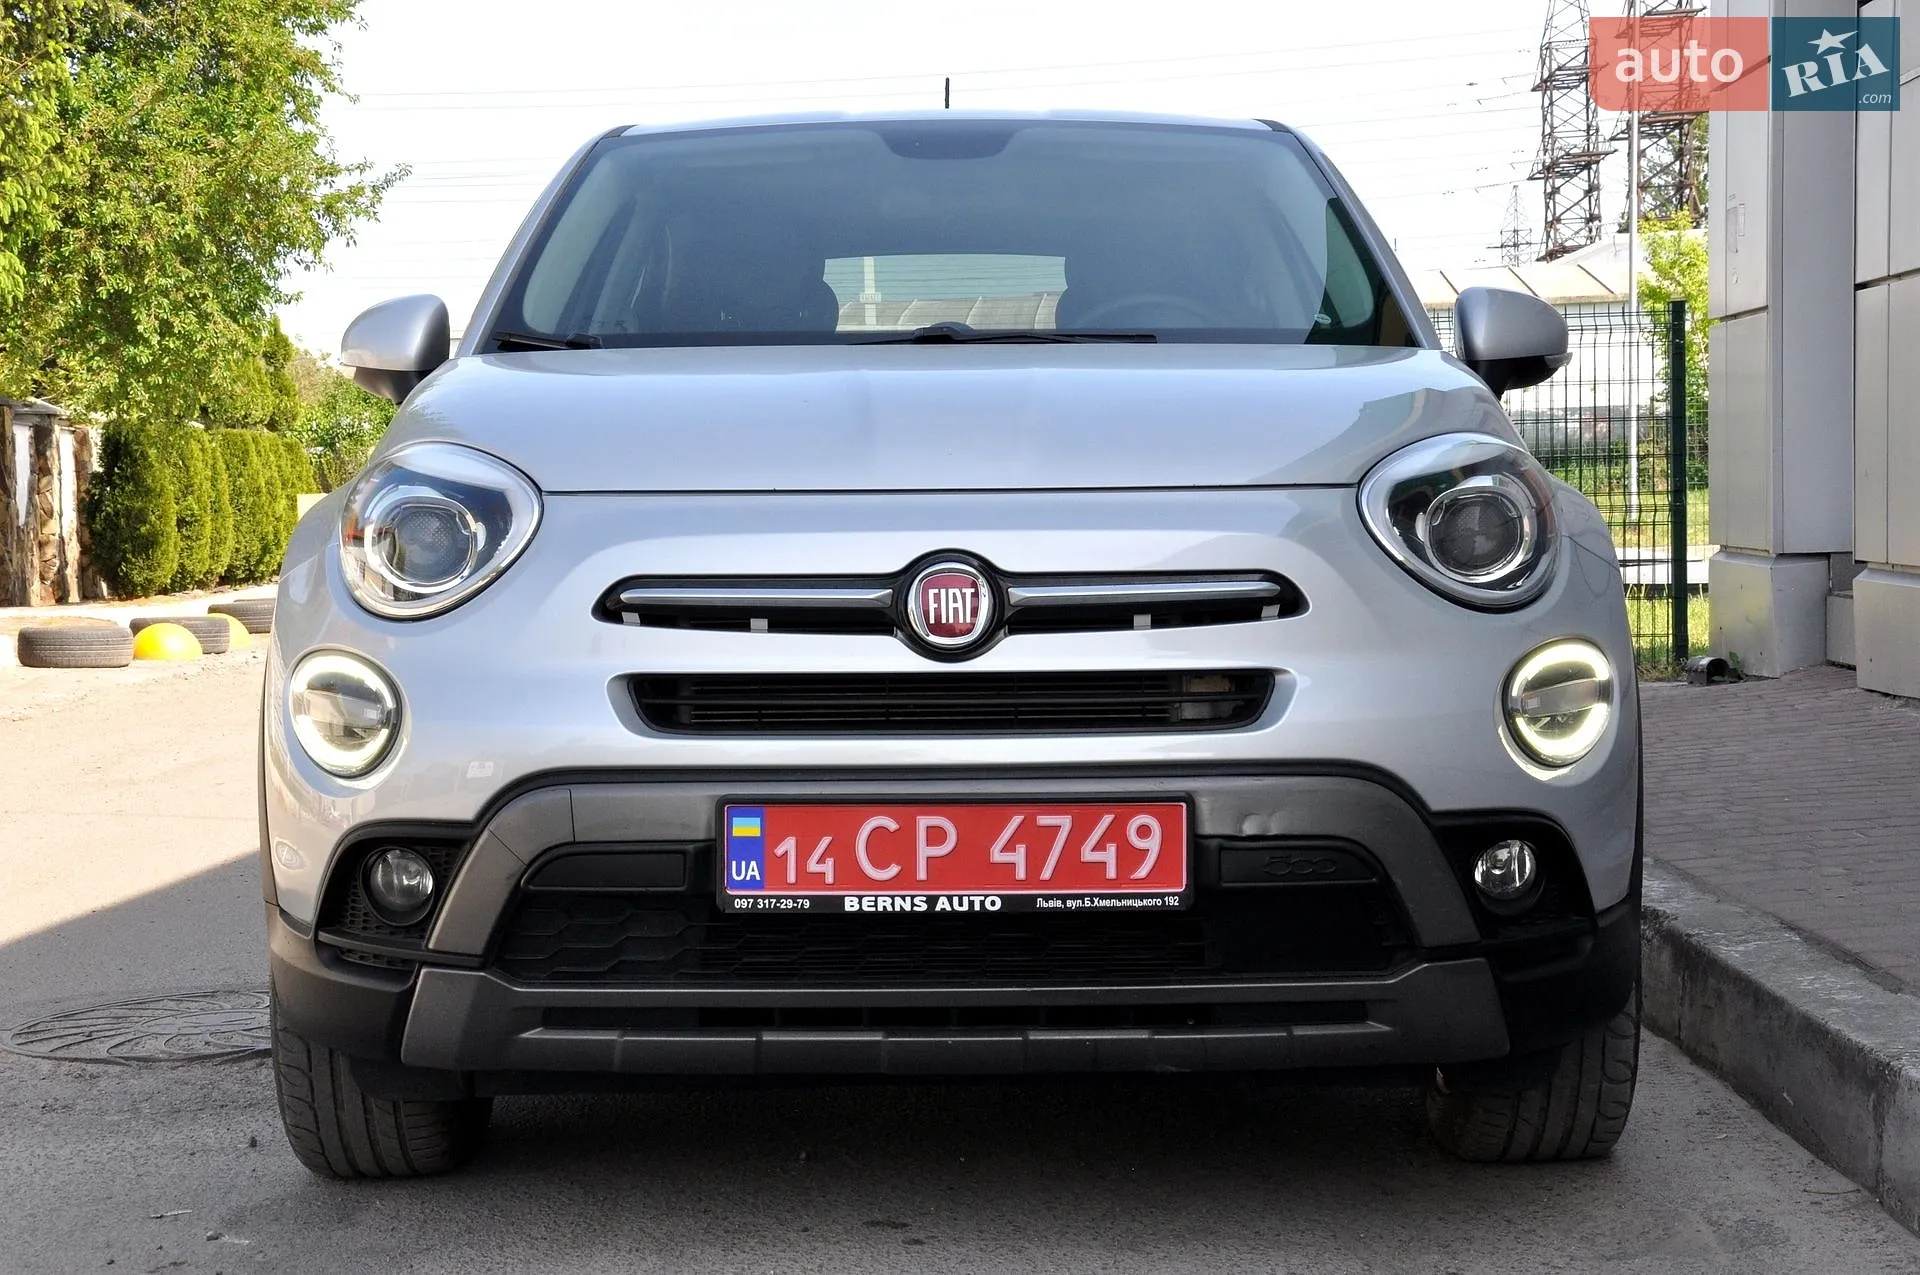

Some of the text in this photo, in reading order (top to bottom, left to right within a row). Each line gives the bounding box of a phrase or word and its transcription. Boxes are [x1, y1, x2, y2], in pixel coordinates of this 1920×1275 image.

[928, 588, 975, 624] FIAT
[773, 814, 1163, 884] 14 CP 4749
[731, 861, 761, 881] UA
[734, 898, 810, 909] 097 317-29-79
[844, 895, 1002, 912] BERNS AUTO
[1036, 897, 1065, 909] Львів,
[1164, 895, 1180, 906] 192
